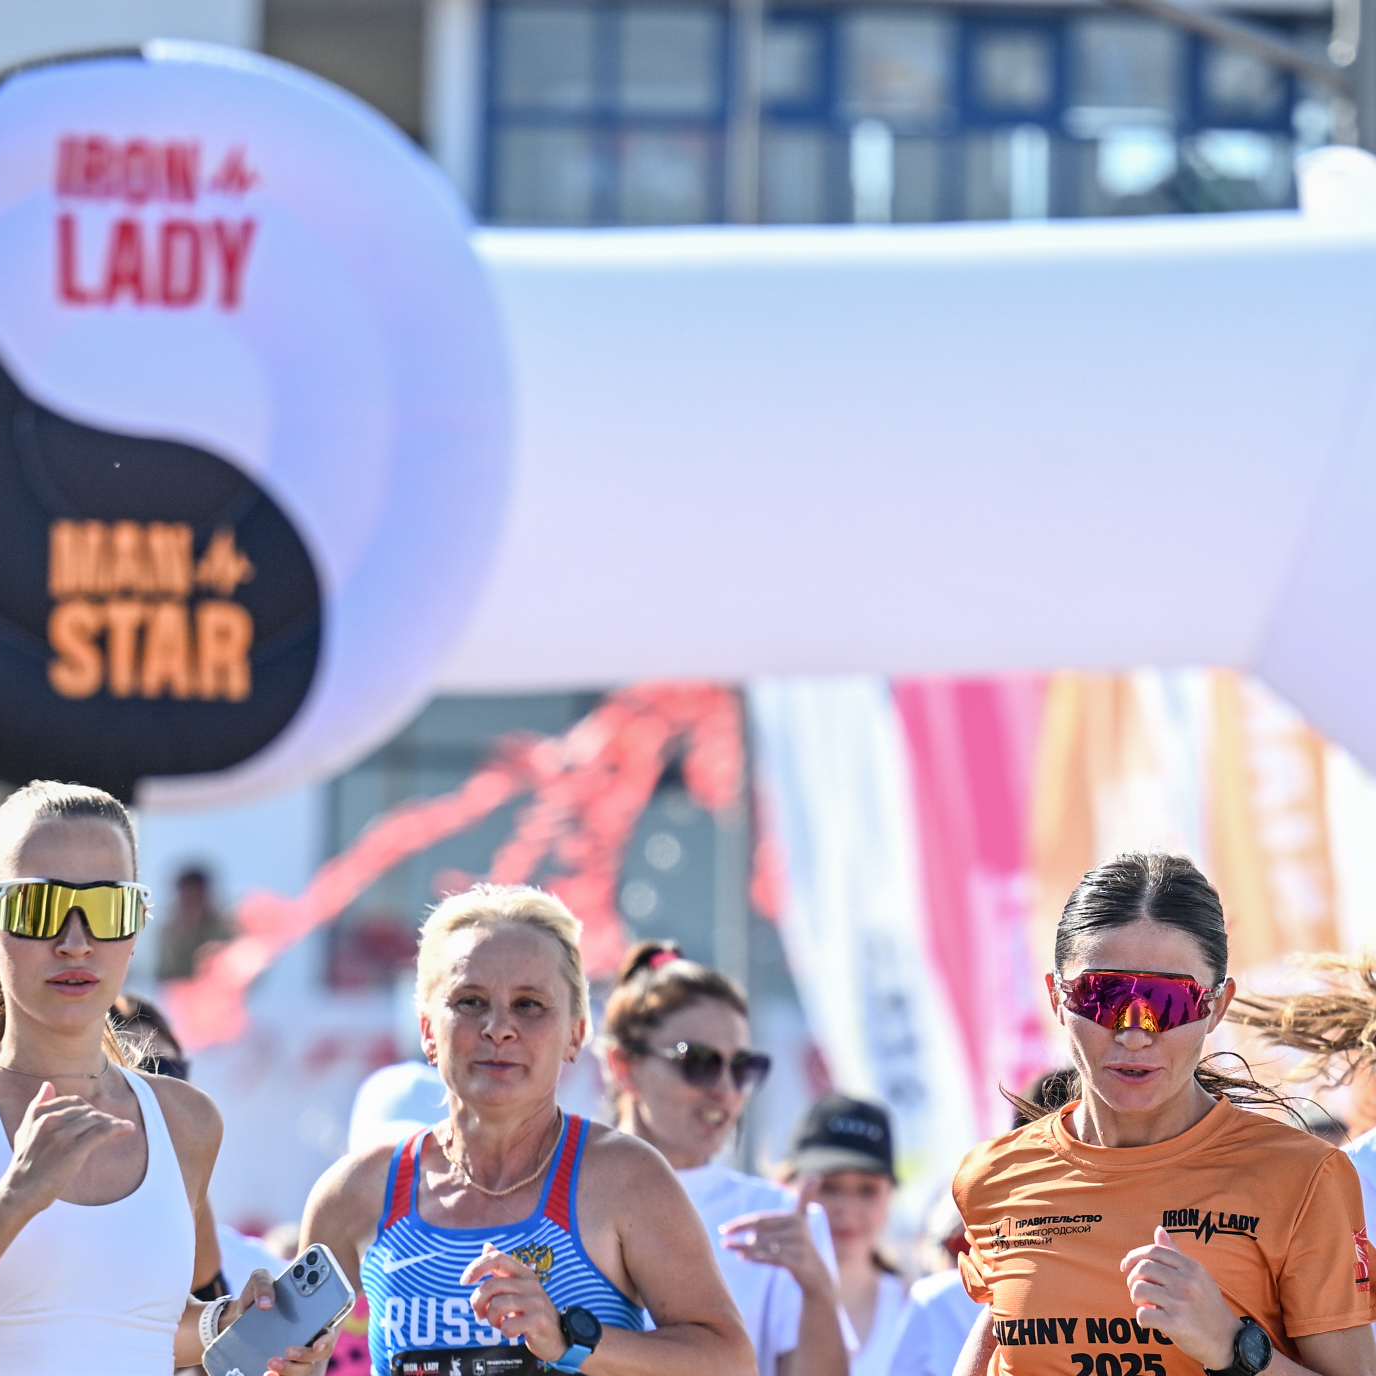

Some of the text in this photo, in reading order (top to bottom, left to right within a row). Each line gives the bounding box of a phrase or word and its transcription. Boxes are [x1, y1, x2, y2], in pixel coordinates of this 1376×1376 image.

[54, 133, 202, 206] IRON
[56, 216, 259, 312] LADY
[48, 519, 194, 599] MAN
[47, 602, 255, 702] STAR
[1015, 1214, 1103, 1229] ПРАВИТЕЛЬСТВО
[1162, 1208, 1260, 1234] IRON LADY
[384, 1296, 520, 1347] RUSS
